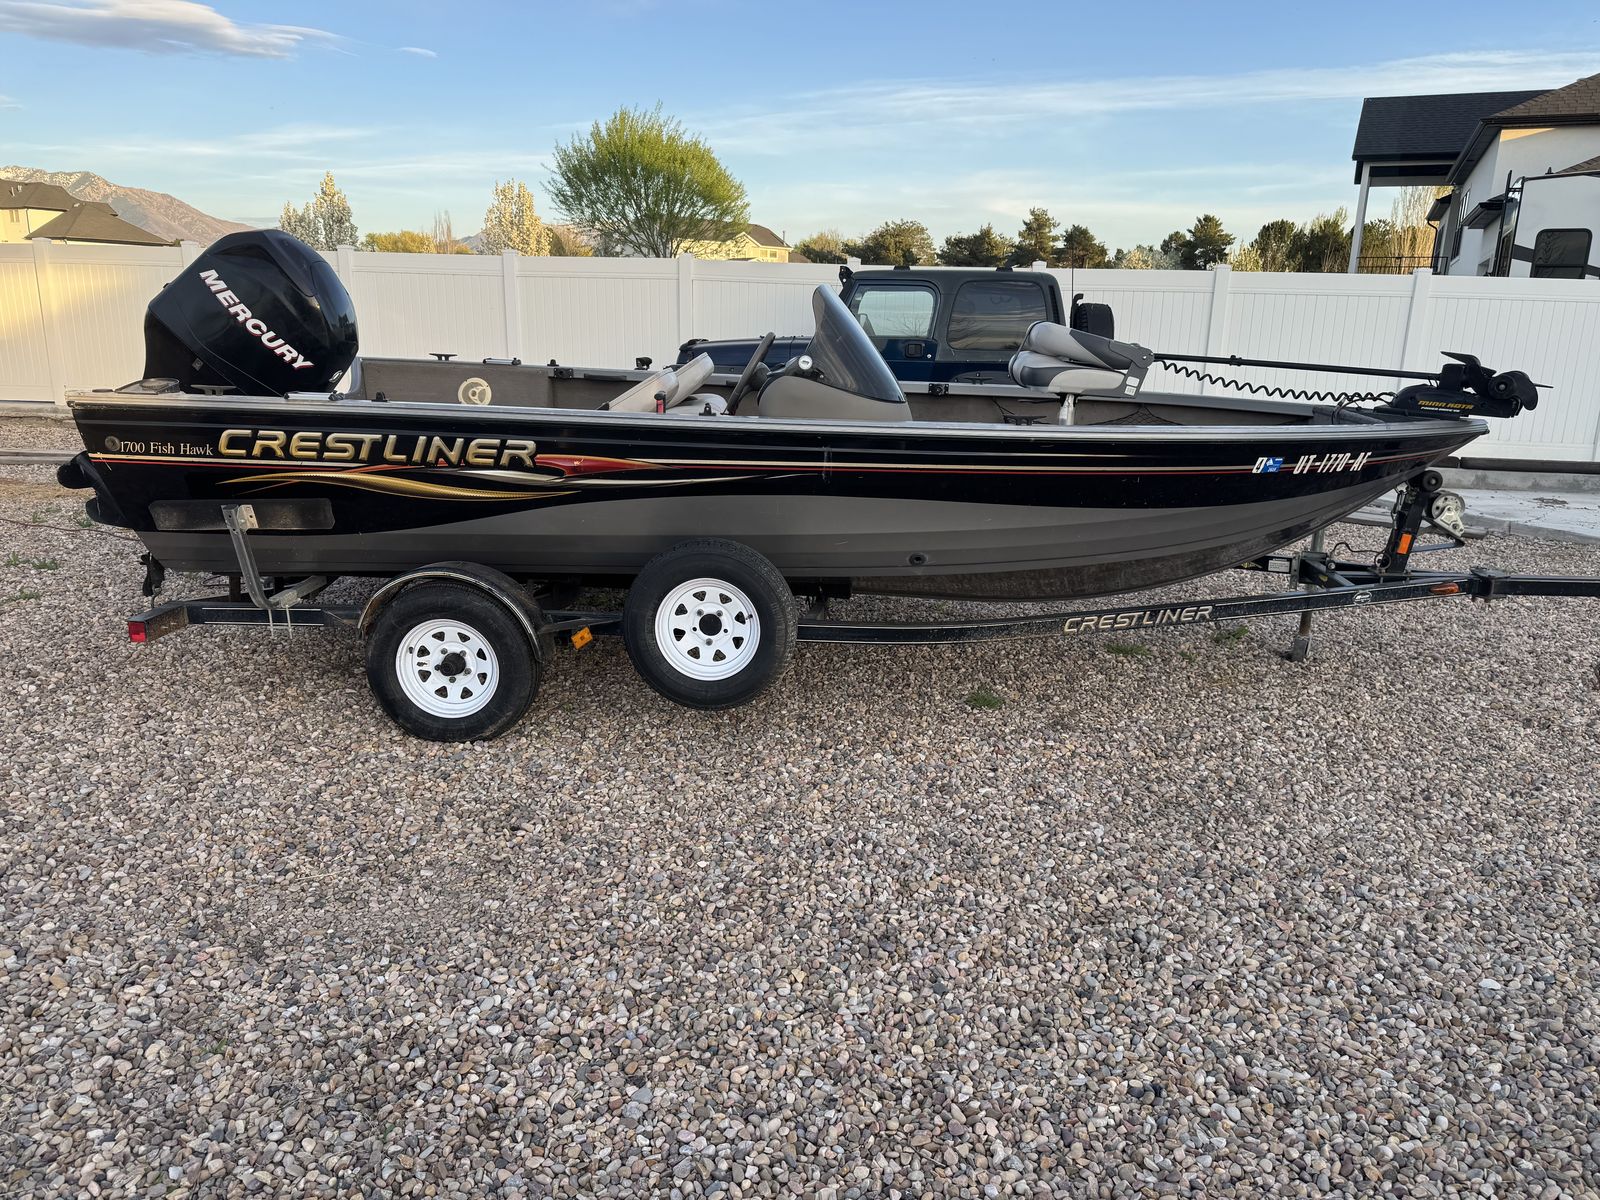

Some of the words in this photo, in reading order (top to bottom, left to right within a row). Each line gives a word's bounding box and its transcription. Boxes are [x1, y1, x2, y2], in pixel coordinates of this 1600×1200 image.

[199, 269, 314, 369] MERCURY
[120, 441, 145, 454] 1700
[150, 442, 175, 455] Fish
[180, 443, 213, 456] Hawk
[218, 428, 536, 468] CRESTLINER
[1063, 605, 1213, 633] CRESTLINER
